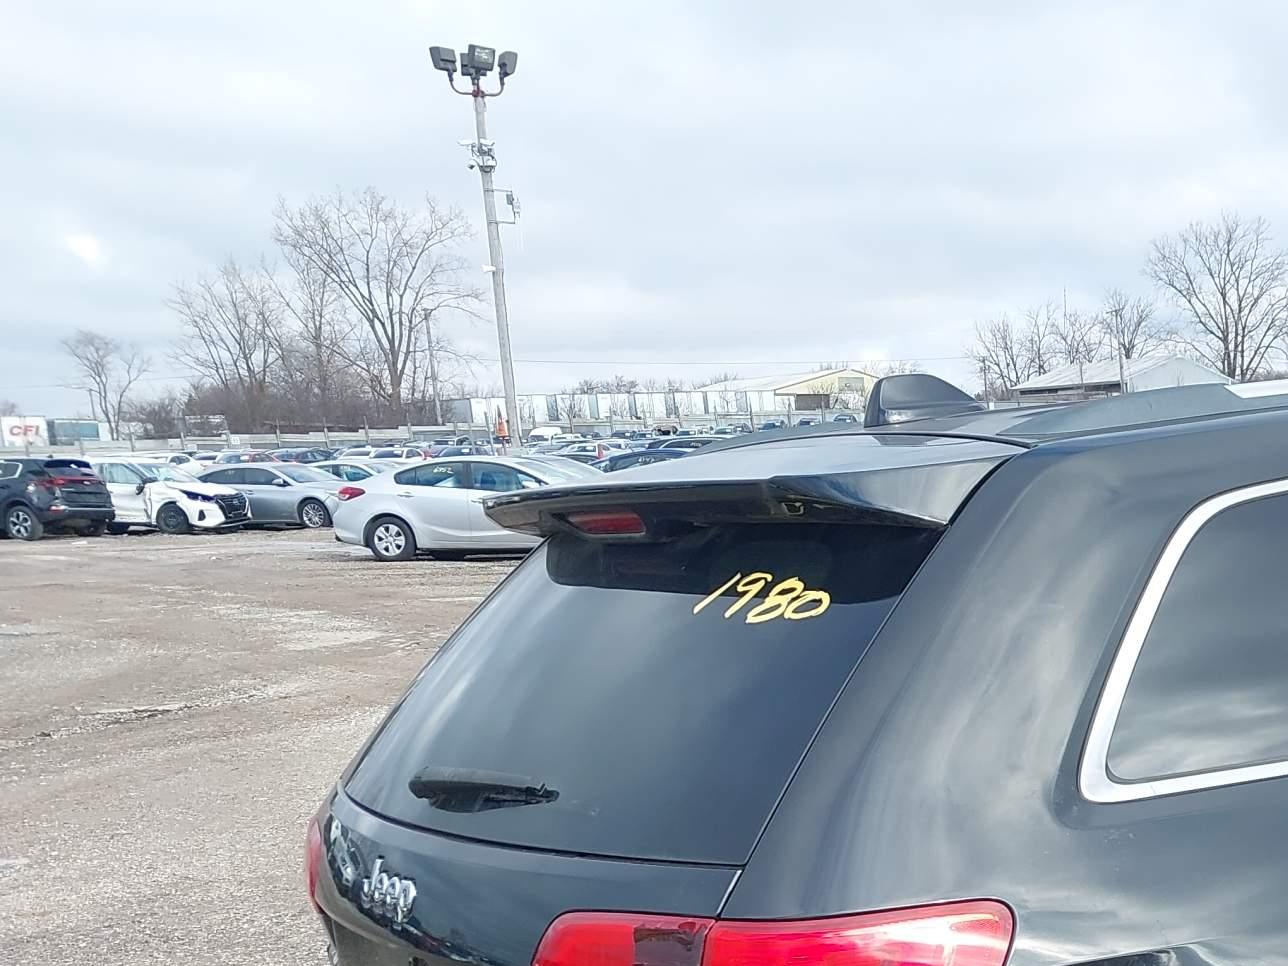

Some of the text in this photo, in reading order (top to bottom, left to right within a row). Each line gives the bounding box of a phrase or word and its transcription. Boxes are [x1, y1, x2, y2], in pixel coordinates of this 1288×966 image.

[9, 424, 40, 437] CFI
[693, 572, 830, 623] 1980
[361, 859, 418, 926] Jeep
